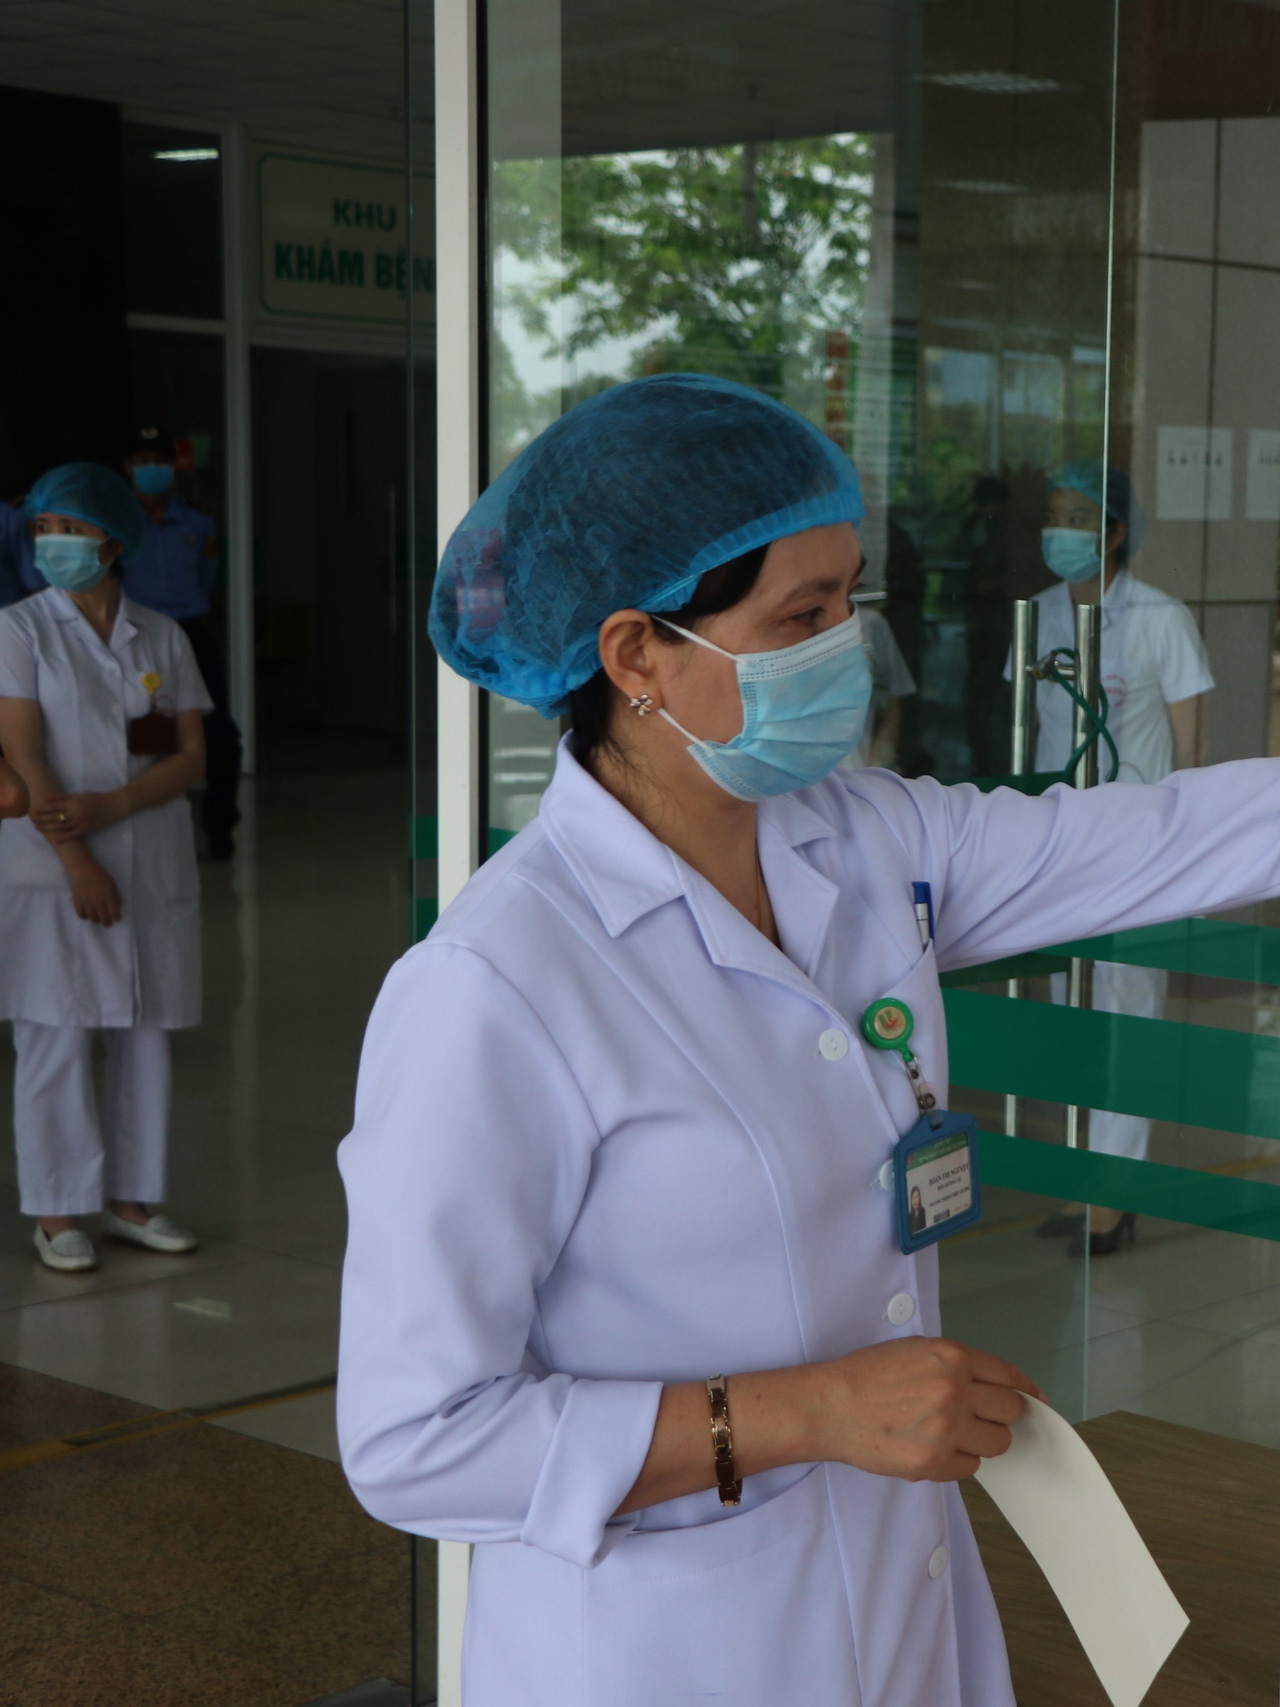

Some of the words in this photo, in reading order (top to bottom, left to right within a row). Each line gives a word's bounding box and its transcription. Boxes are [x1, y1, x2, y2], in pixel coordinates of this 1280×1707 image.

[333, 199, 397, 231] KHU
[275, 240, 365, 288] KHÁM
[376, 247, 436, 298] BỆN
